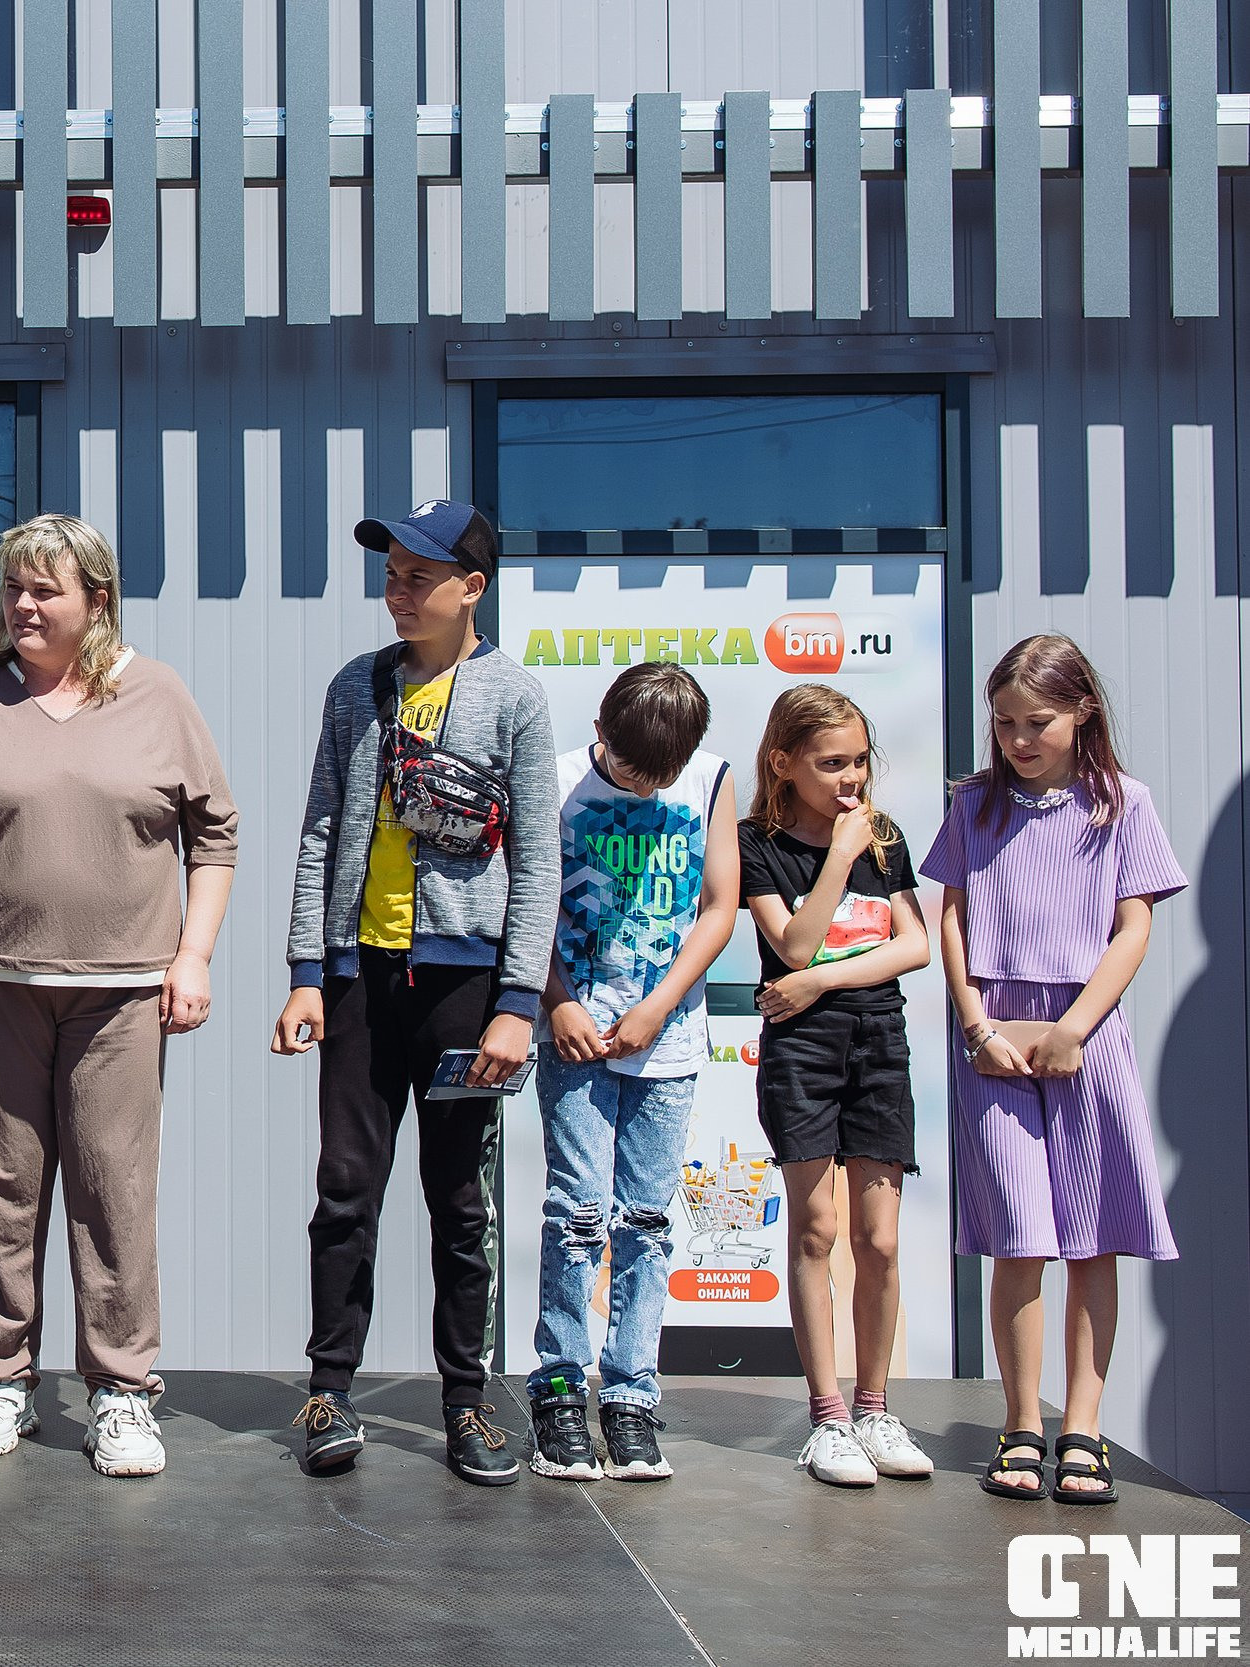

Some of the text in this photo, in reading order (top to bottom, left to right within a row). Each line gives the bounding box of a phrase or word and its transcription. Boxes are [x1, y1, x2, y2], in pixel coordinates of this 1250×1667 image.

[523, 628, 760, 666] АПТЕКА
[584, 833, 688, 874] YOUNG
[601, 876, 673, 917] WILD
[696, 1272, 751, 1284] ЗАКАЖИ
[697, 1287, 750, 1300] ОНЛАЙН
